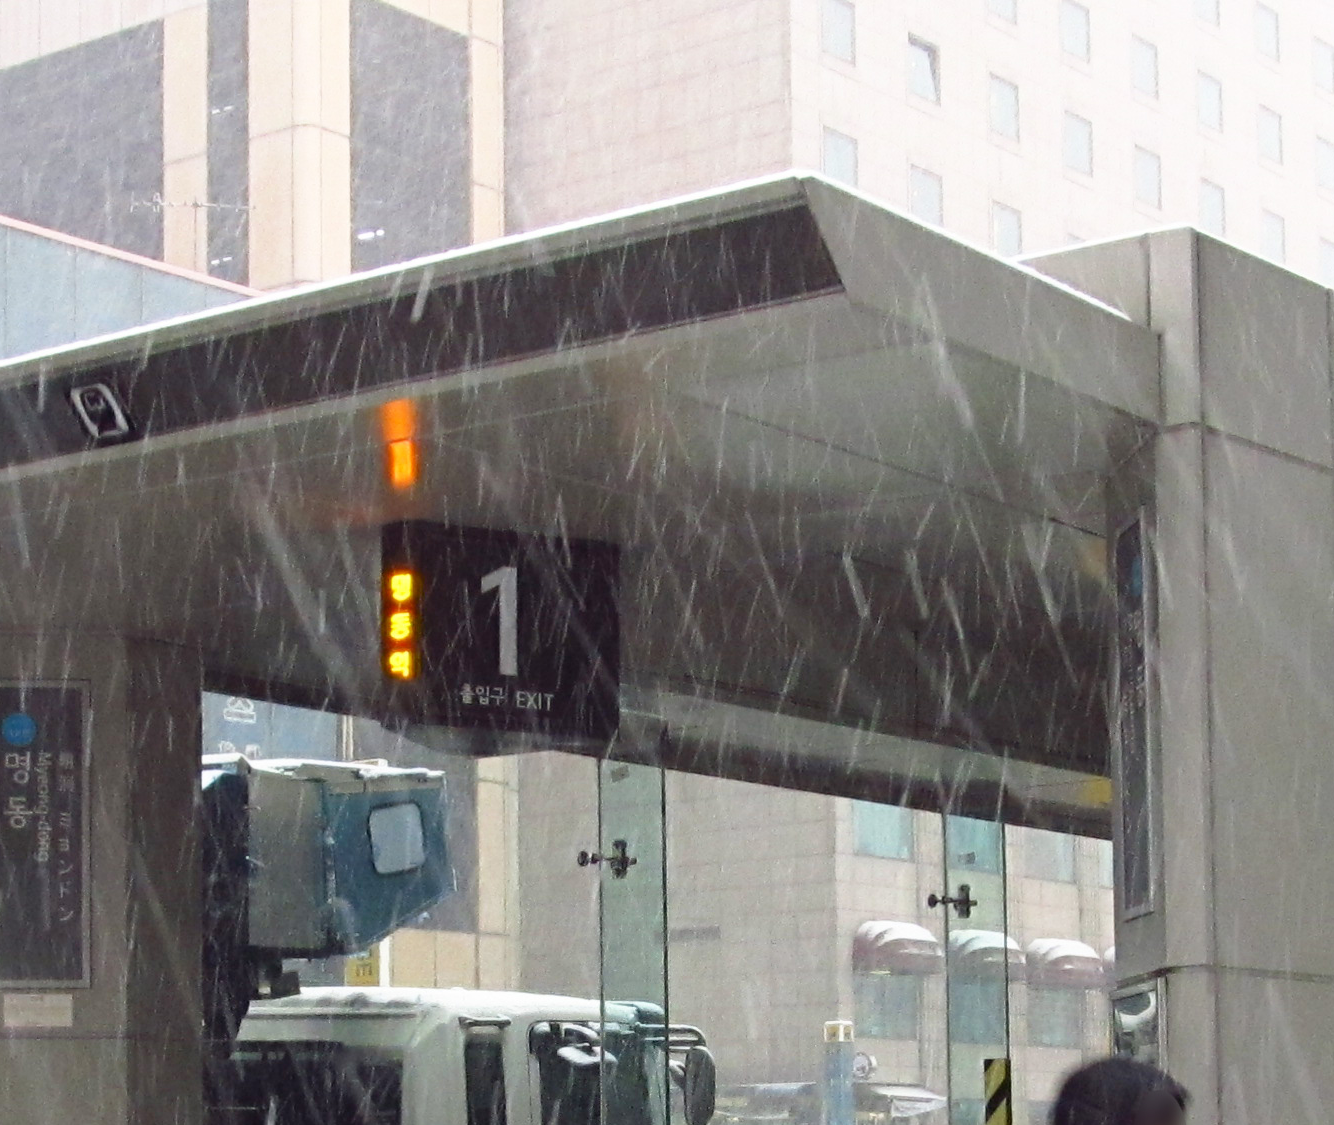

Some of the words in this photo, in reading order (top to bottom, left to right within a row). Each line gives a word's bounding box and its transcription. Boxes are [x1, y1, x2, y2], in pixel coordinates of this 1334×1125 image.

[389, 573, 412, 678] 명동역
[480, 566, 518, 677] 1
[460, 683, 509, 706] 출입구
[517, 690, 555, 711] EXIT
